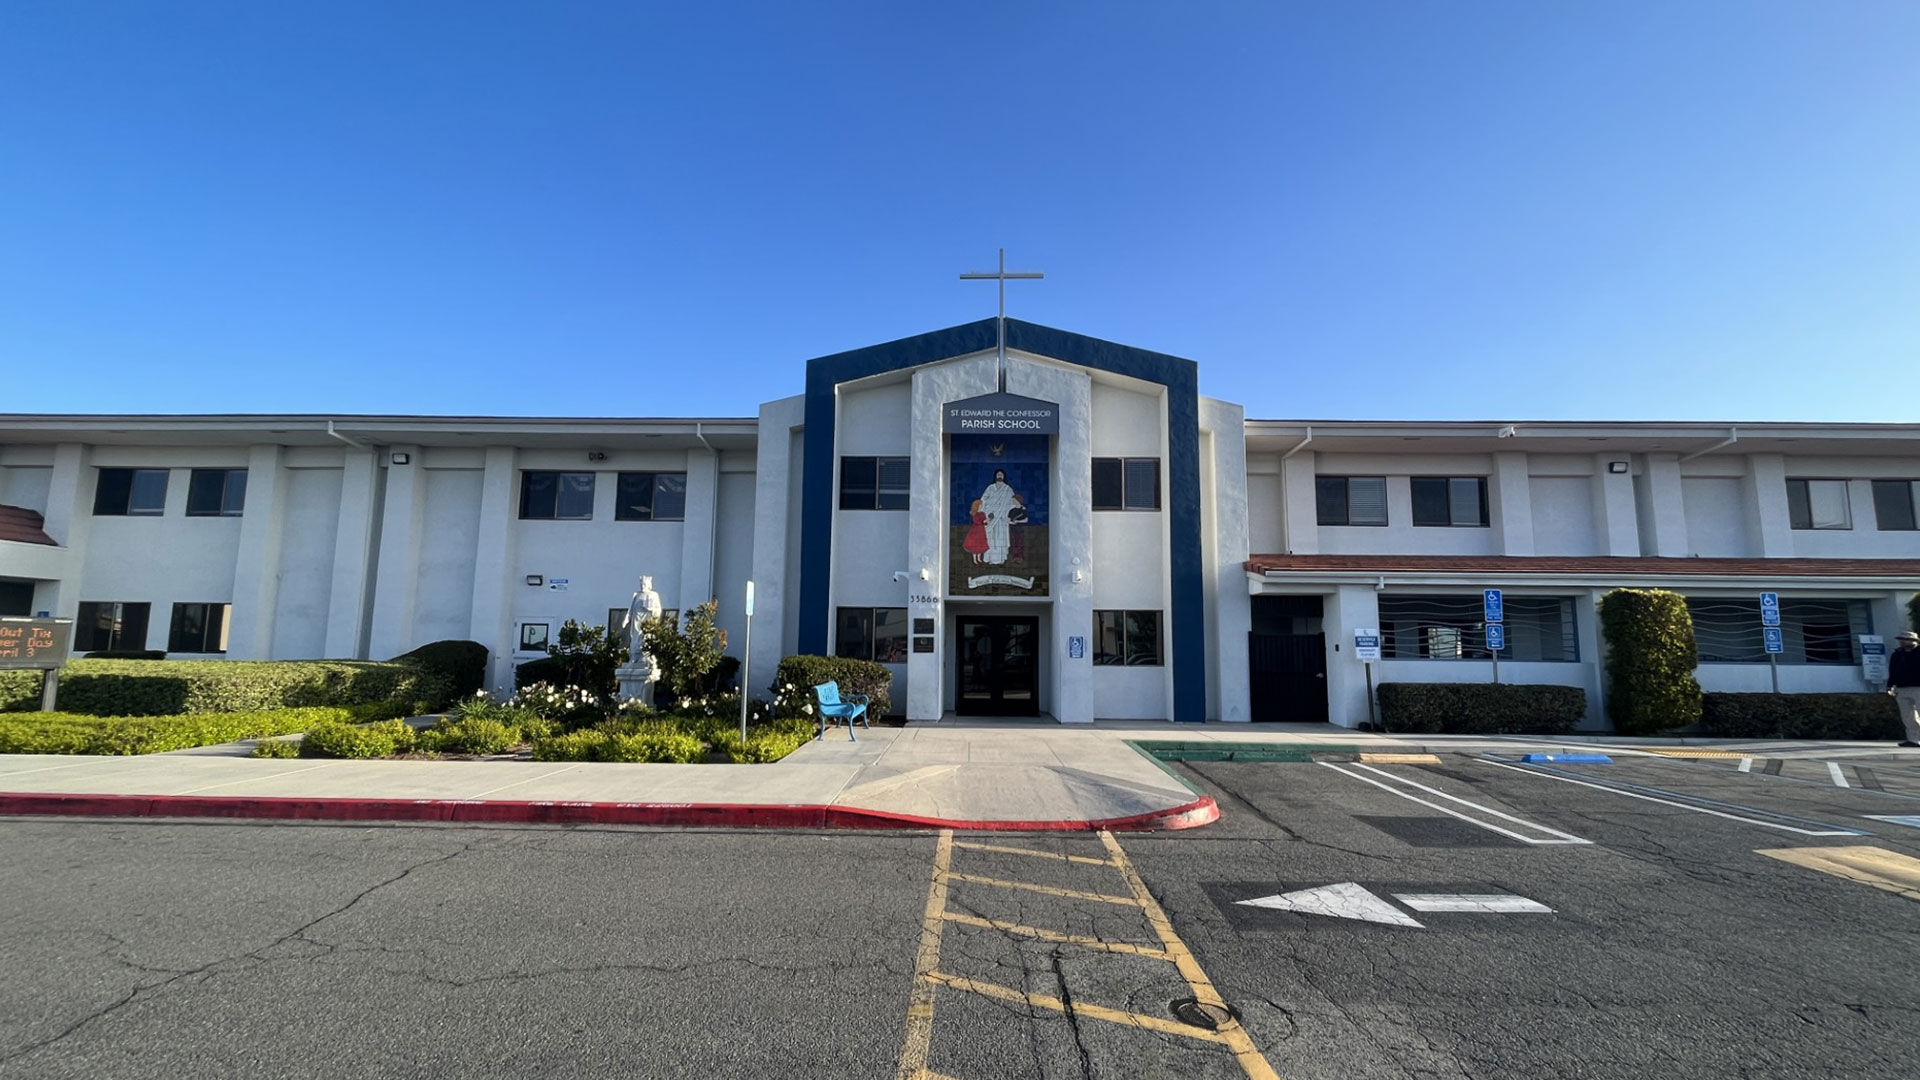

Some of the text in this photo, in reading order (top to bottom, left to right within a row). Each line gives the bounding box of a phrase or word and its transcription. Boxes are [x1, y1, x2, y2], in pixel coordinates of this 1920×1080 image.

[961, 409, 992, 417] EDWARD
[993, 409, 1005, 417] THE
[1006, 409, 1051, 417] CONFESSOR
[961, 420, 1040, 429] PARISH SCHOOL
[28, 637, 53, 647] Day
[26, 648, 34, 657] 3
